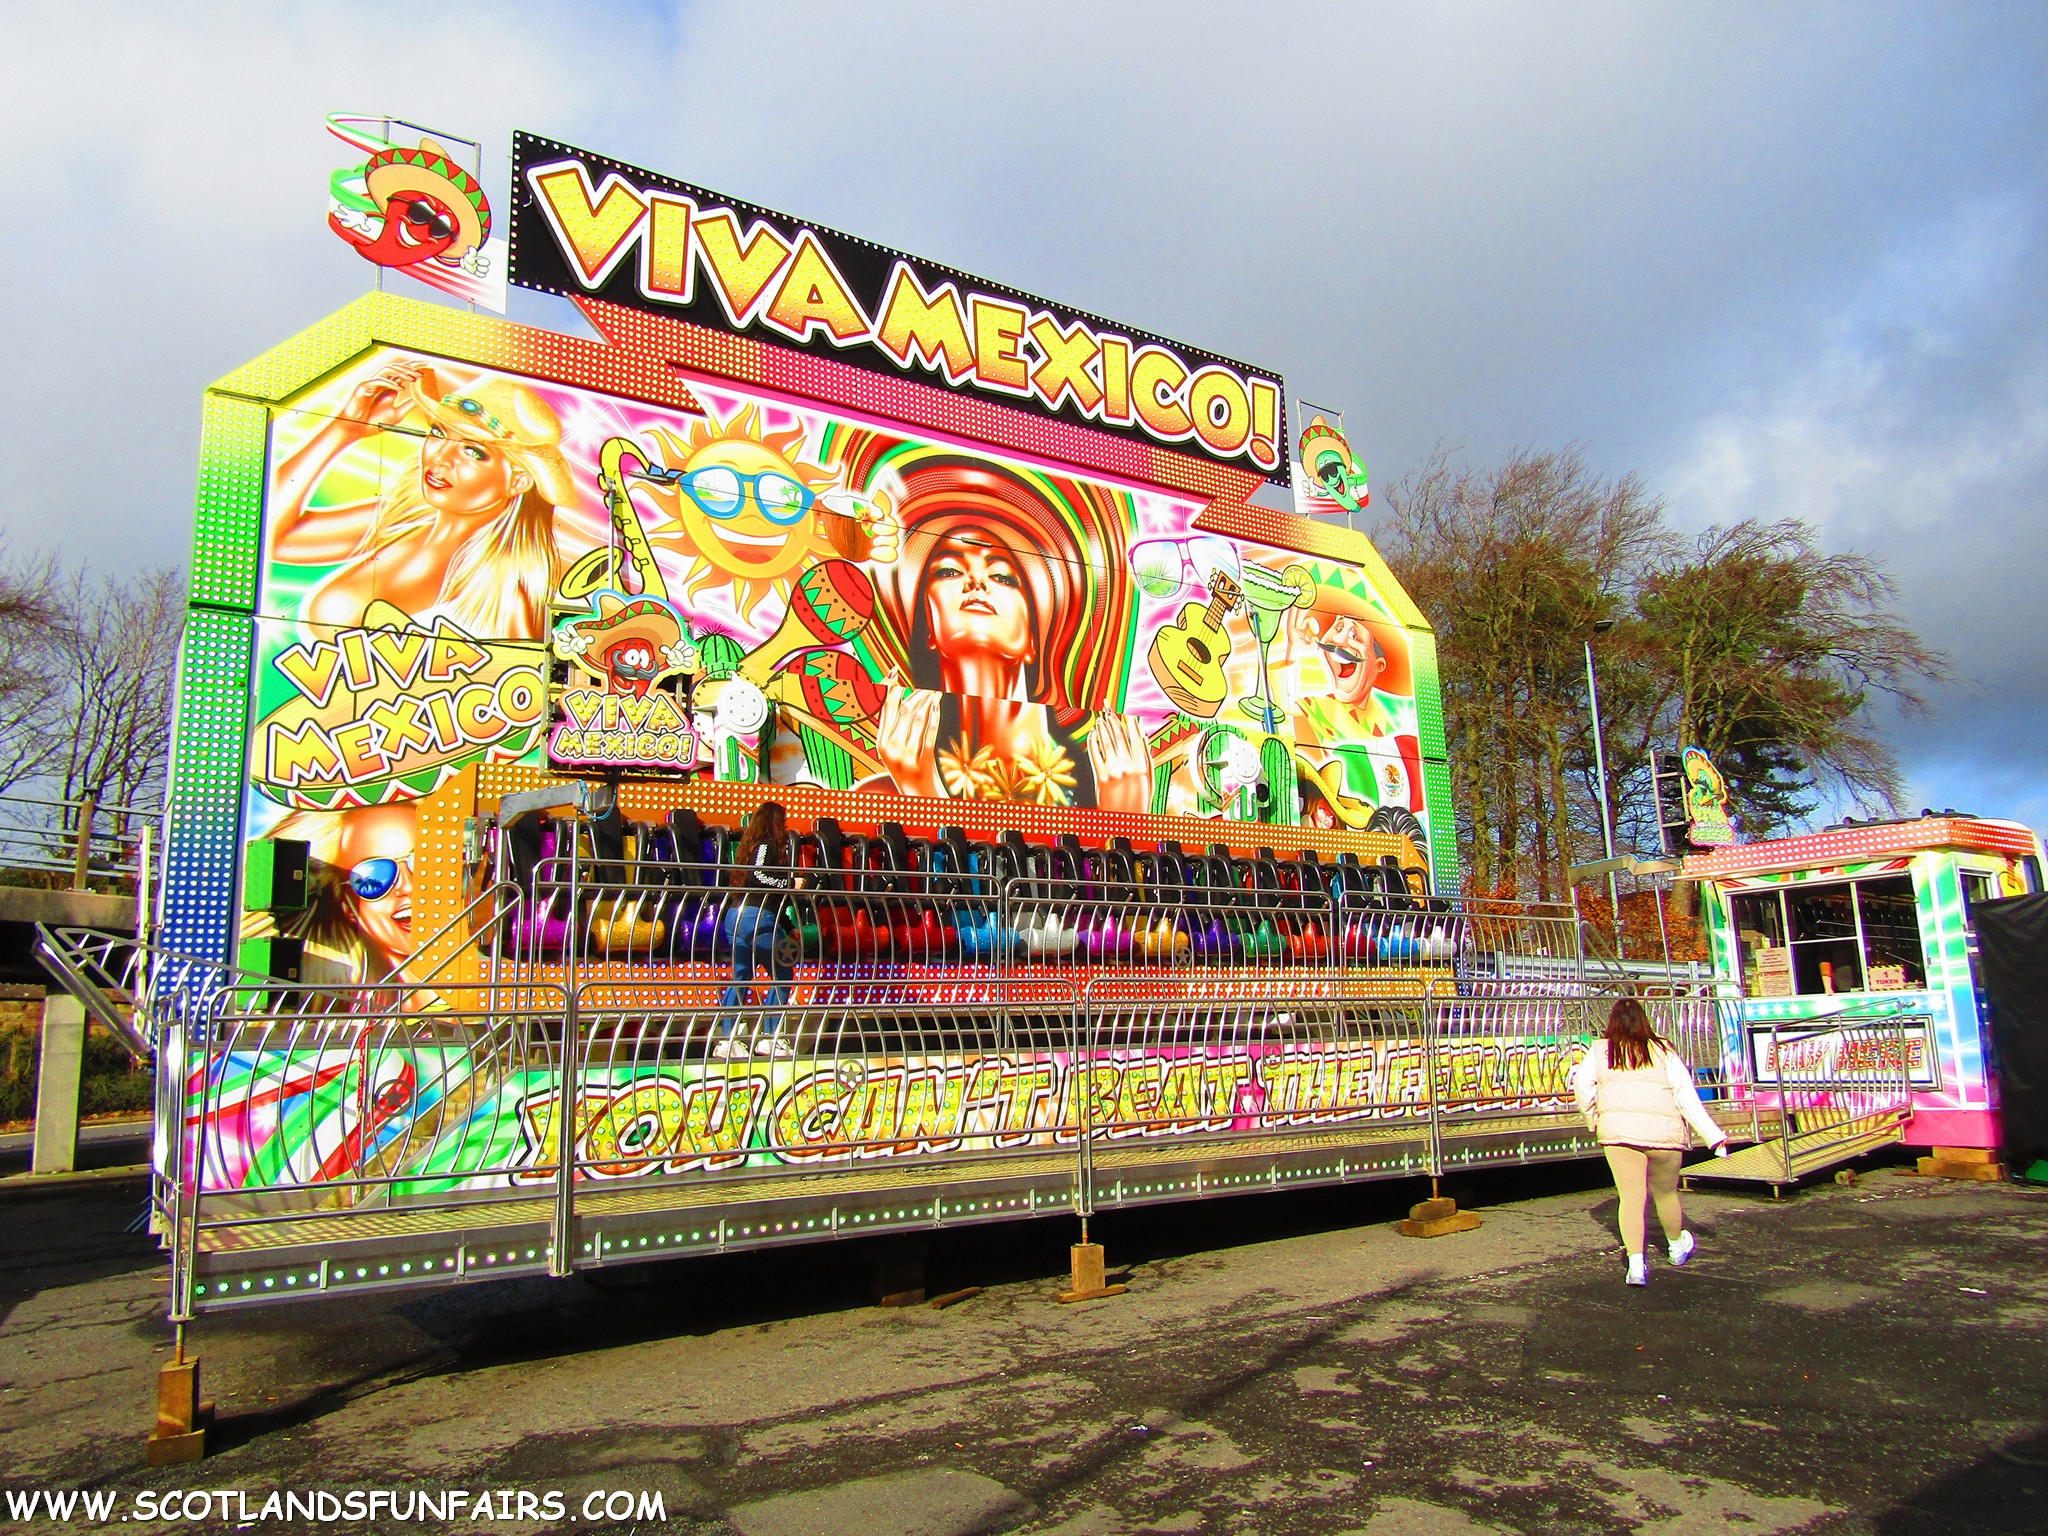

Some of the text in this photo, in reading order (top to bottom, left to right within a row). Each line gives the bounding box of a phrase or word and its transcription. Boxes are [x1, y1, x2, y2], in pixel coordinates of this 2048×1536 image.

[530, 162, 1283, 470] VIVA MEXICO!
[278, 617, 489, 705] VIVA
[565, 690, 683, 732] VIVA
[553, 730, 695, 764] MEXICO!
[1766, 1036, 1924, 1072] PAY HERE
[515, 1080, 765, 1181] YOU
[772, 1063, 1054, 1159] CAN'T
[1057, 1058, 1250, 1140] BEAT
[1259, 1053, 1374, 1125] THE
